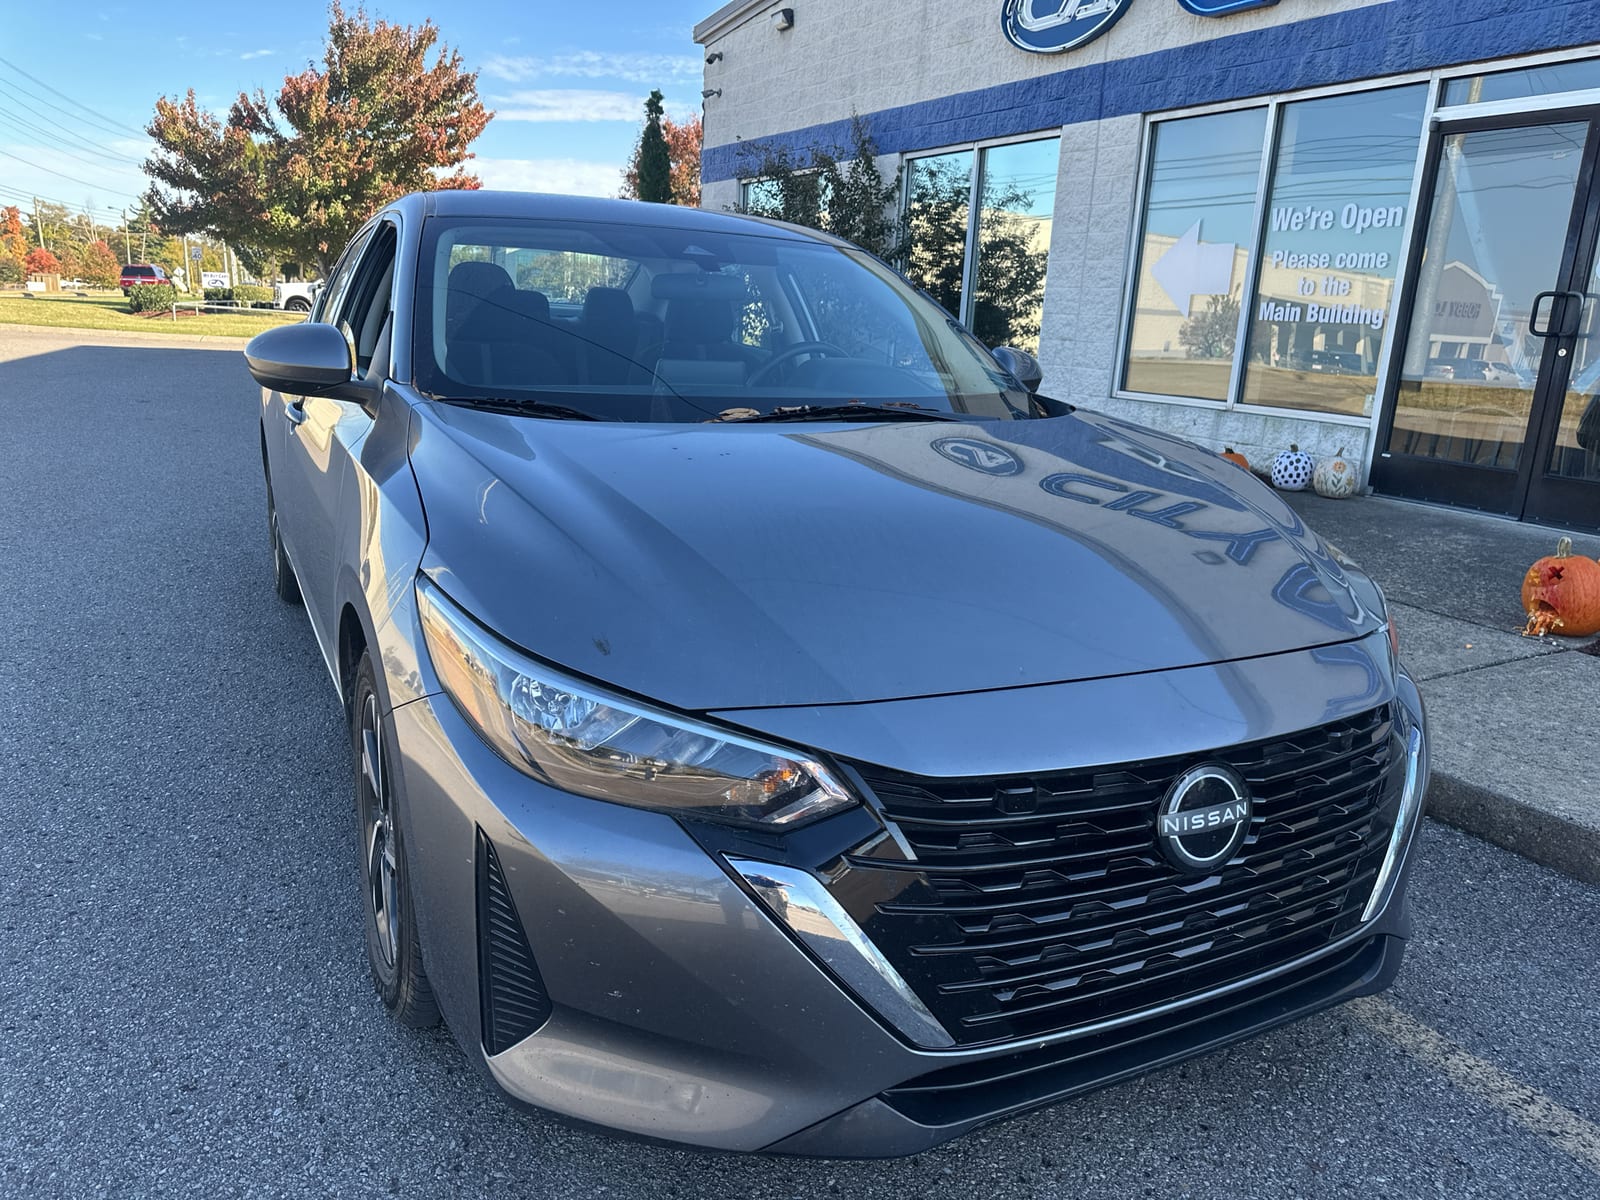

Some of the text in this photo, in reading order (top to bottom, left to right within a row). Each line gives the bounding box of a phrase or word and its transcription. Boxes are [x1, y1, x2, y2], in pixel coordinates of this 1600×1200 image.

[1271, 202, 1404, 234] We're Open
[1271, 250, 1389, 269] Please come
[1298, 275, 1351, 297] to the
[1258, 302, 1385, 330] Main Building
[1164, 802, 1247, 833] NISSAN
